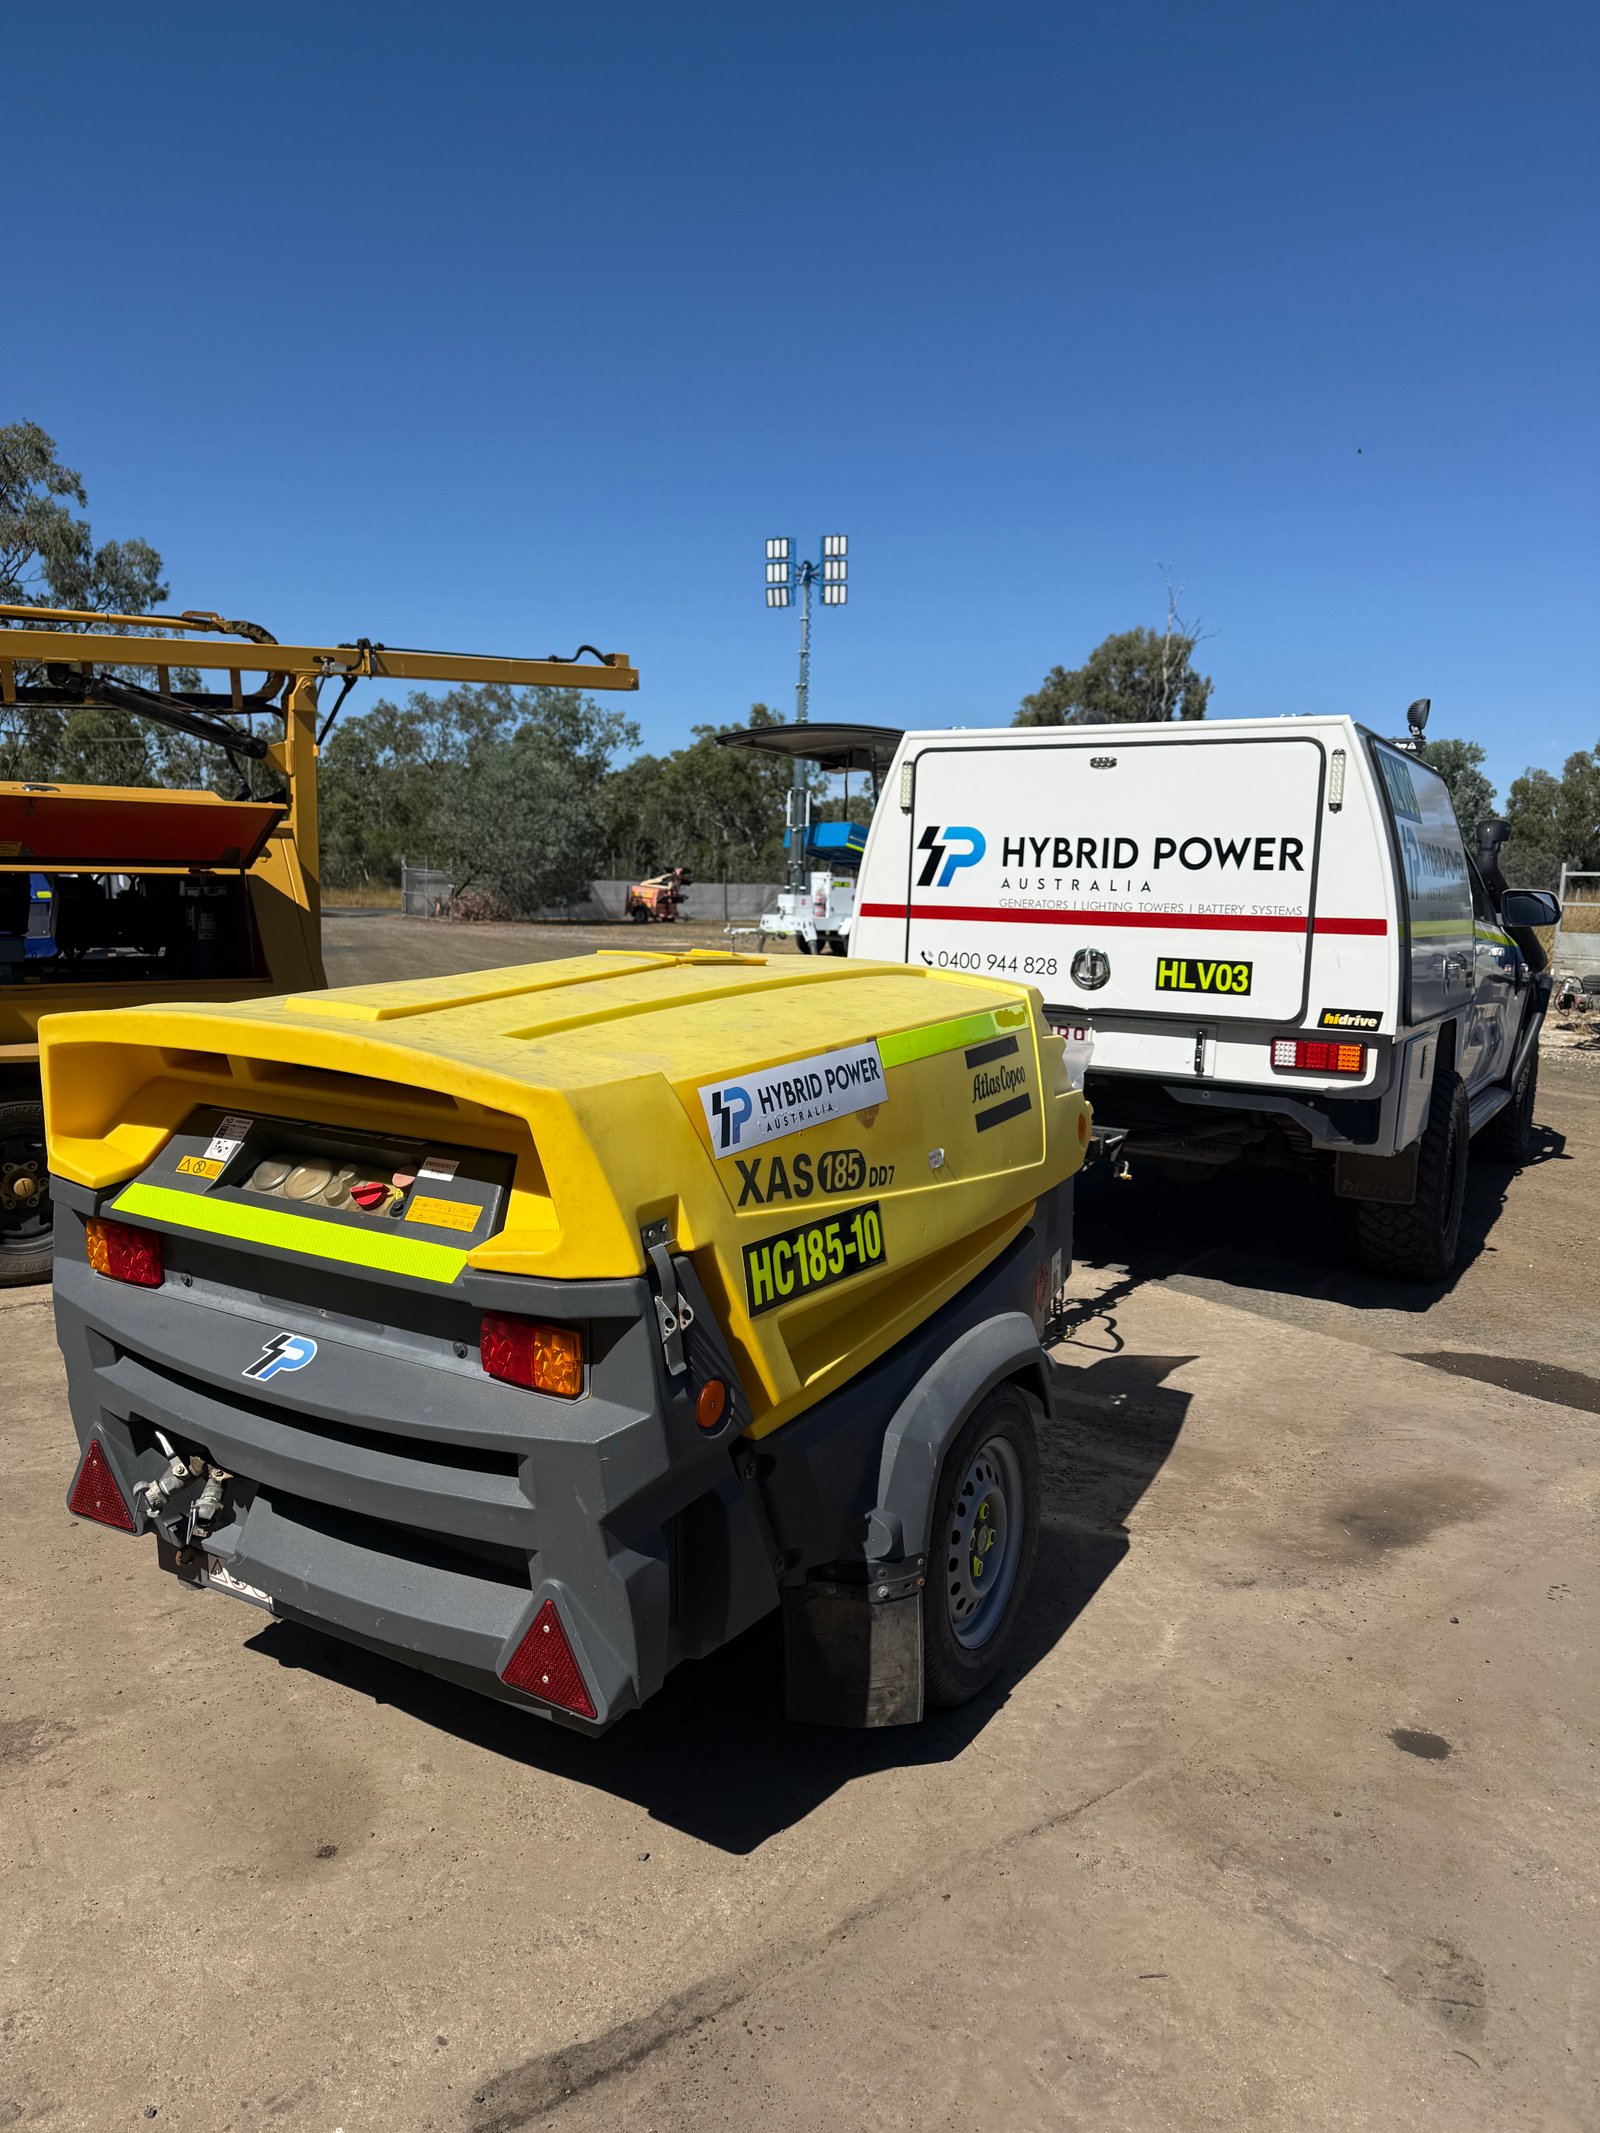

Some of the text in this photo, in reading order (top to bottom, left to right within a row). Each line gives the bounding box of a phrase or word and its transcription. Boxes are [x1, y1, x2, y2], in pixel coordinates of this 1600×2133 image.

[1002, 836, 1304, 871] HYBRID POWER
[1001, 878, 1151, 892] AUSTRALIA
[999, 898, 1069, 909] GENERATORS
[1081, 901, 1133, 912] LIGHTING
[1139, 902, 1184, 913] TOWERS
[1198, 904, 1245, 914] BATTERY
[1251, 905, 1303, 916] SYSTEMS
[938, 951, 1058, 975] 0400 944 828
[1158, 960, 1249, 992] HLV03
[1323, 1013, 1378, 1027] hidrive
[758, 1056, 881, 1114] HYBRID POWER
[972, 1065, 1026, 1103] Atlas Copco
[766, 1103, 834, 1132] AUSTRALIA
[734, 1151, 895, 1207] XAS 185 DD7
[749, 1210, 882, 1306] HC185-10
